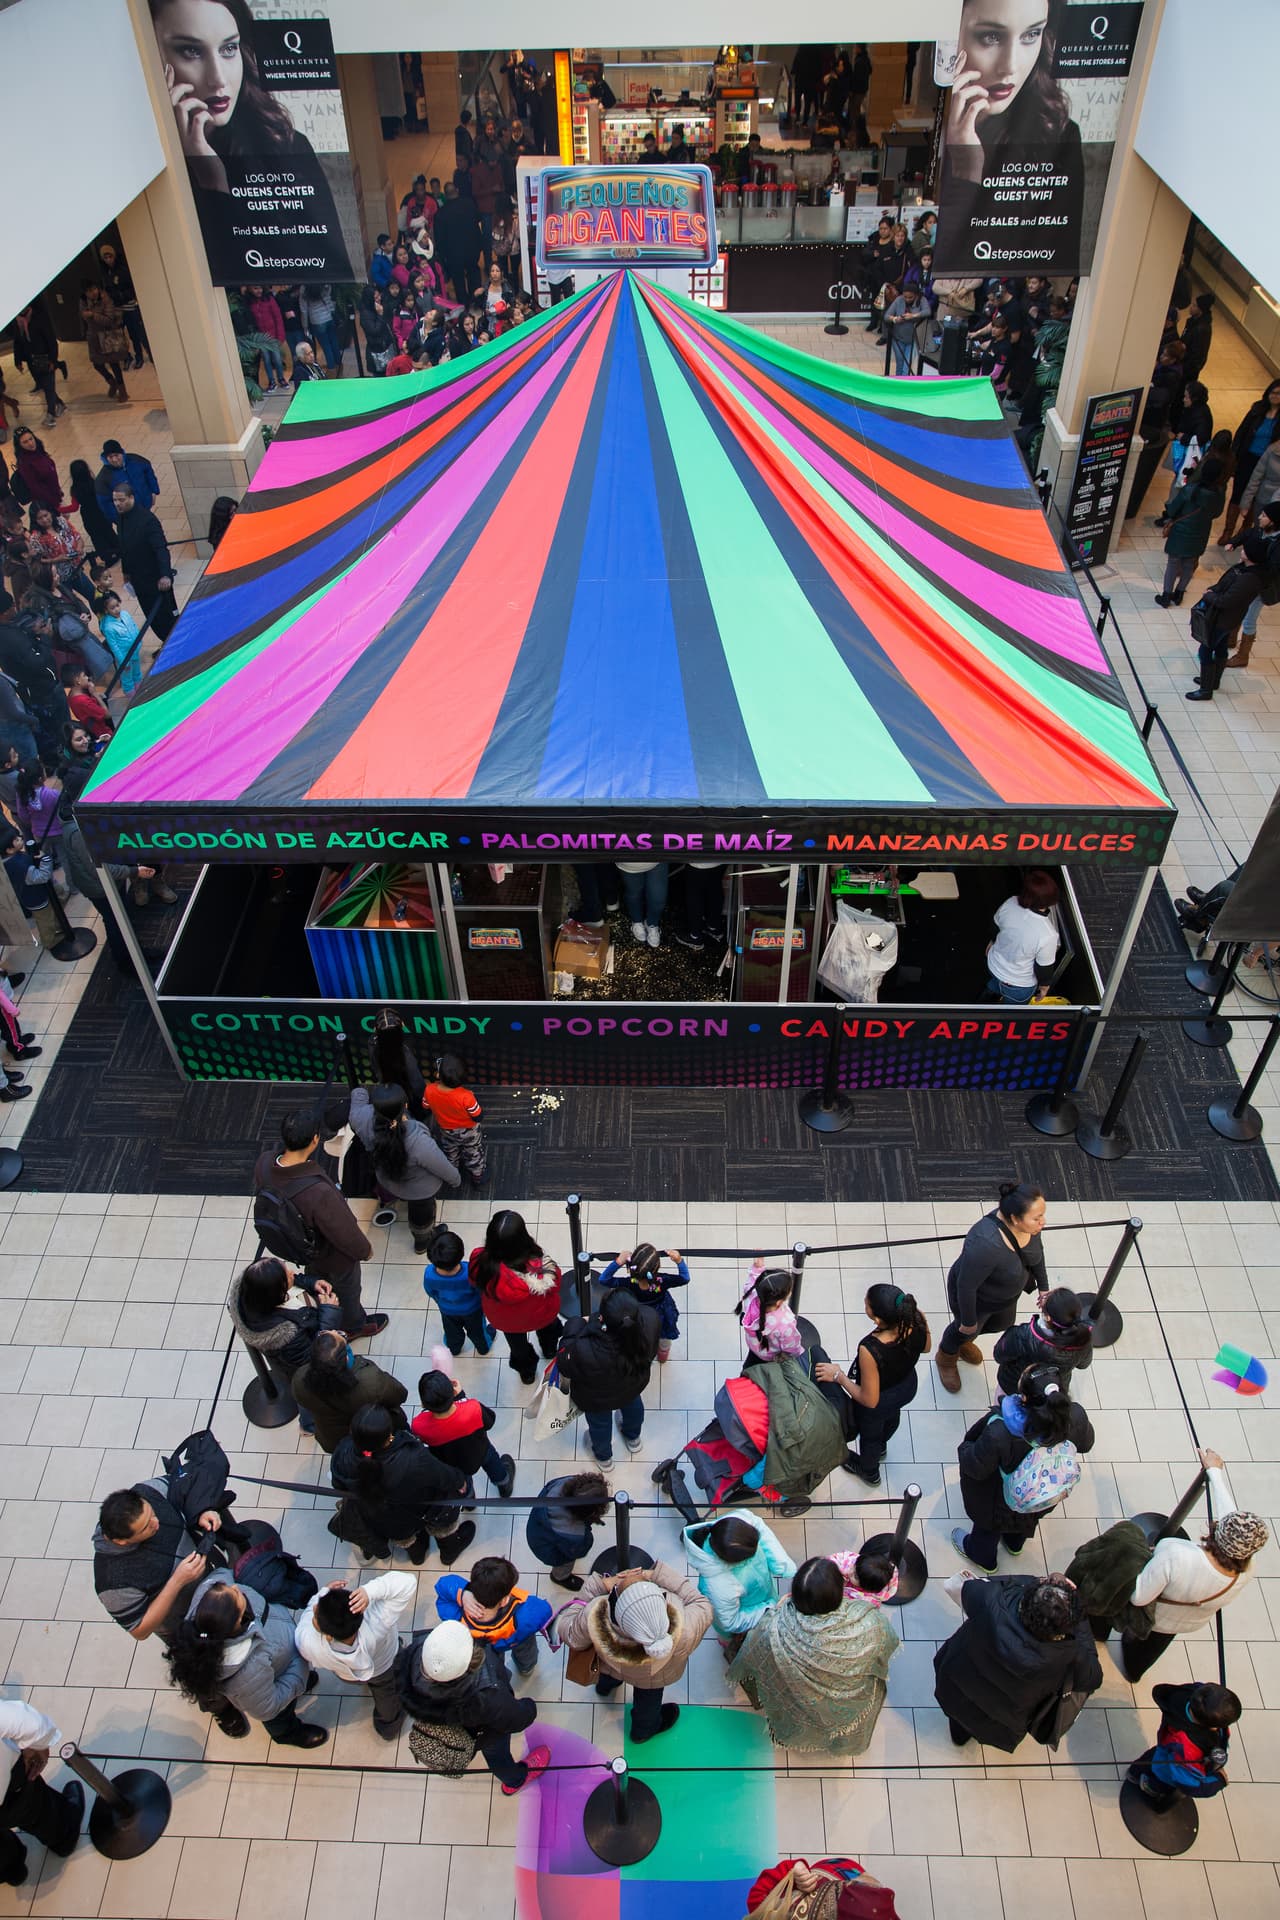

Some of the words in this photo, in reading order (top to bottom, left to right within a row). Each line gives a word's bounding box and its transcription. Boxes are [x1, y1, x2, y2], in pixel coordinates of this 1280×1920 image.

[1061, 45, 1094, 54] QUEENS
[263, 58, 295, 67] QUEENS
[1058, 59, 1080, 67] WHERE
[1001, 163, 1022, 173] LOG
[1023, 163, 1039, 172] ON
[1040, 162, 1054, 172] TO
[245, 174, 265, 183] LOG
[266, 173, 281, 183] ON
[281, 173, 295, 182] TO
[982, 177, 1025, 188] QUEENS
[1027, 176, 1069, 187] CENTER
[231, 188, 273, 198] QUEENS
[274, 186, 315, 197] CENTER
[561, 178, 689, 208] PEQUEÑOS
[993, 191, 1028, 201] GUEST
[1030, 190, 1053, 200] WIFI
[247, 201, 279, 211] GUEST
[281, 200, 304, 210] WIFI
[970, 217, 989, 227] Find
[990, 216, 1019, 226] SALES
[1020, 216, 1037, 226] and
[1037, 215, 1068, 225] DEALS
[232, 226, 251, 237] Find
[252, 226, 280, 236] SALES
[281, 225, 297, 235] and
[298, 224, 328, 235] DEALS
[545, 208, 708, 247] GIGANTES
[991, 248, 1055, 261] stepsaway
[263, 256, 326, 269] stepsaway
[117, 830, 267, 849] ALGODÓN
[275, 832, 318, 849] DE
[326, 827, 449, 849] AZÚCAR
[481, 832, 653, 851] PALOMITAS
[662, 833, 704, 851] DE
[714, 829, 793, 852] MAÍZ
[826, 834, 1008, 852] MANZANAS
[1017, 833, 1137, 853] DULCES
[471, 936, 521, 945] GIGANTES
[753, 936, 804, 946] GIGANES
[191, 1013, 343, 1033] COTTON
[360, 1015, 492, 1036] CNDY
[543, 1017, 728, 1037] POPCORN
[928, 1020, 1072, 1040] APPLES
